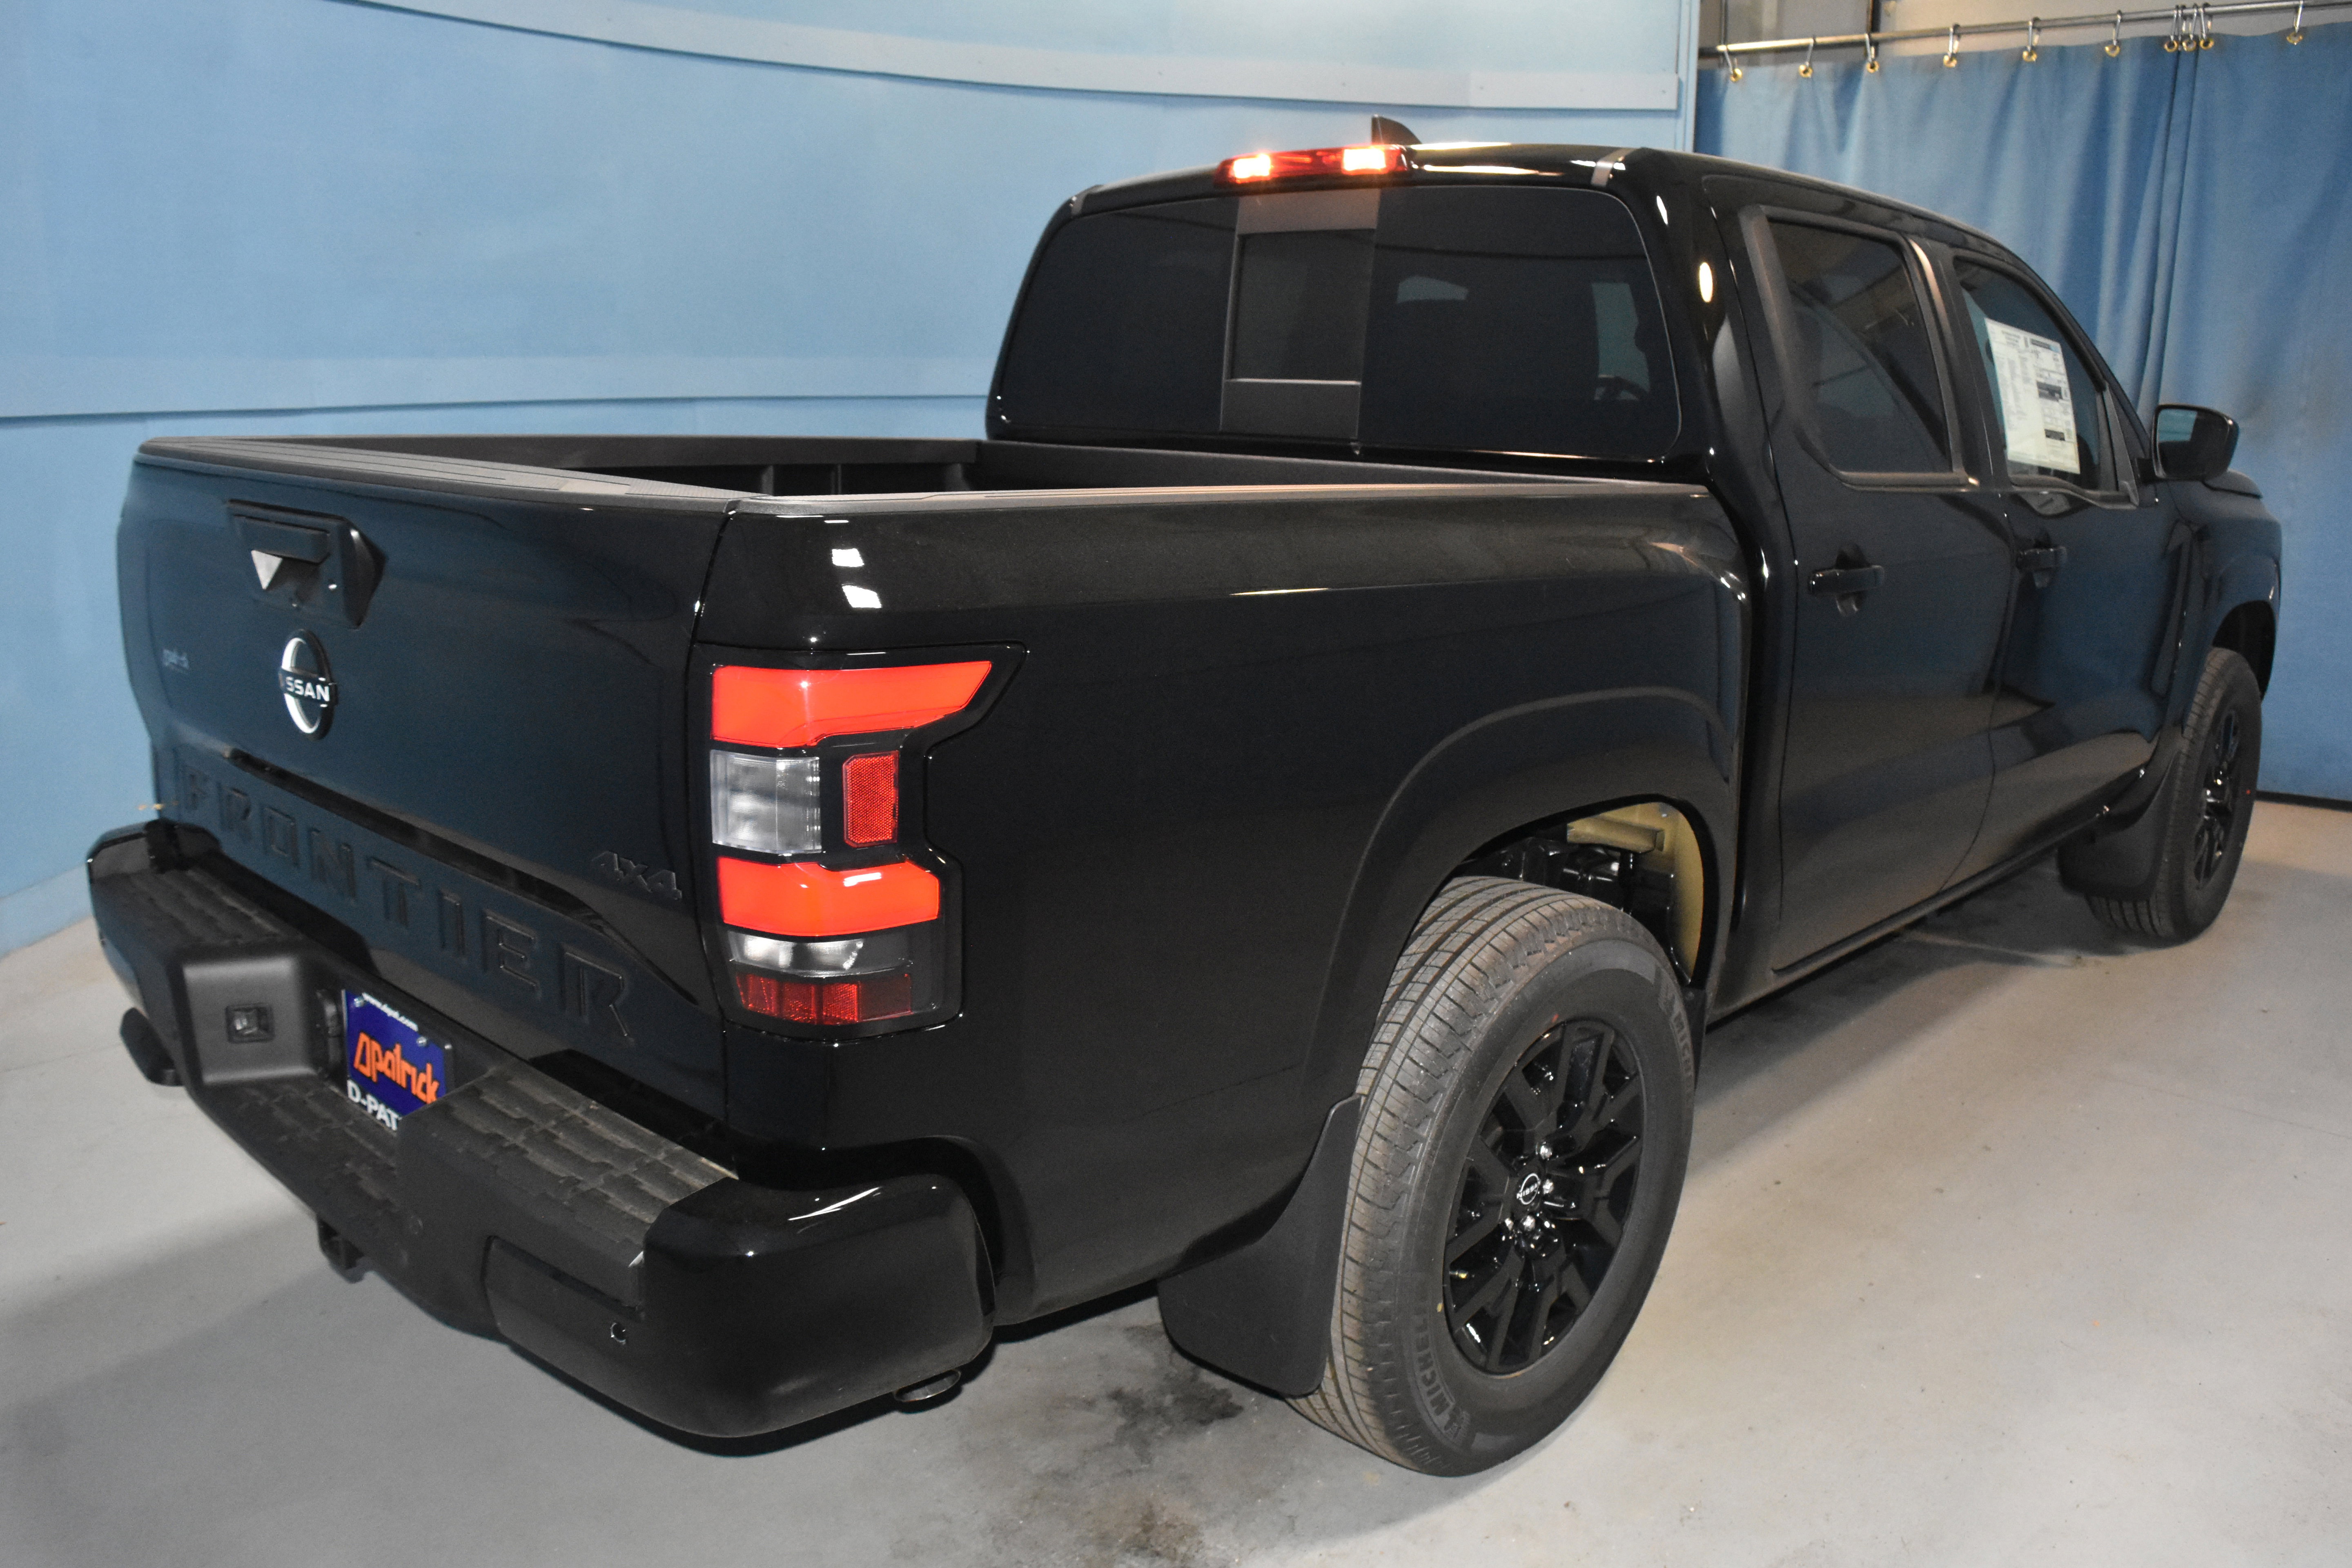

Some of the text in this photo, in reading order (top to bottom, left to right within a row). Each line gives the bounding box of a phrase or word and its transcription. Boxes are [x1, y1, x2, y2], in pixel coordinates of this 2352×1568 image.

[284, 675, 331, 703] SSAN
[177, 755, 633, 1049] FRONTIER
[347, 1079, 402, 1131] D-PAT
